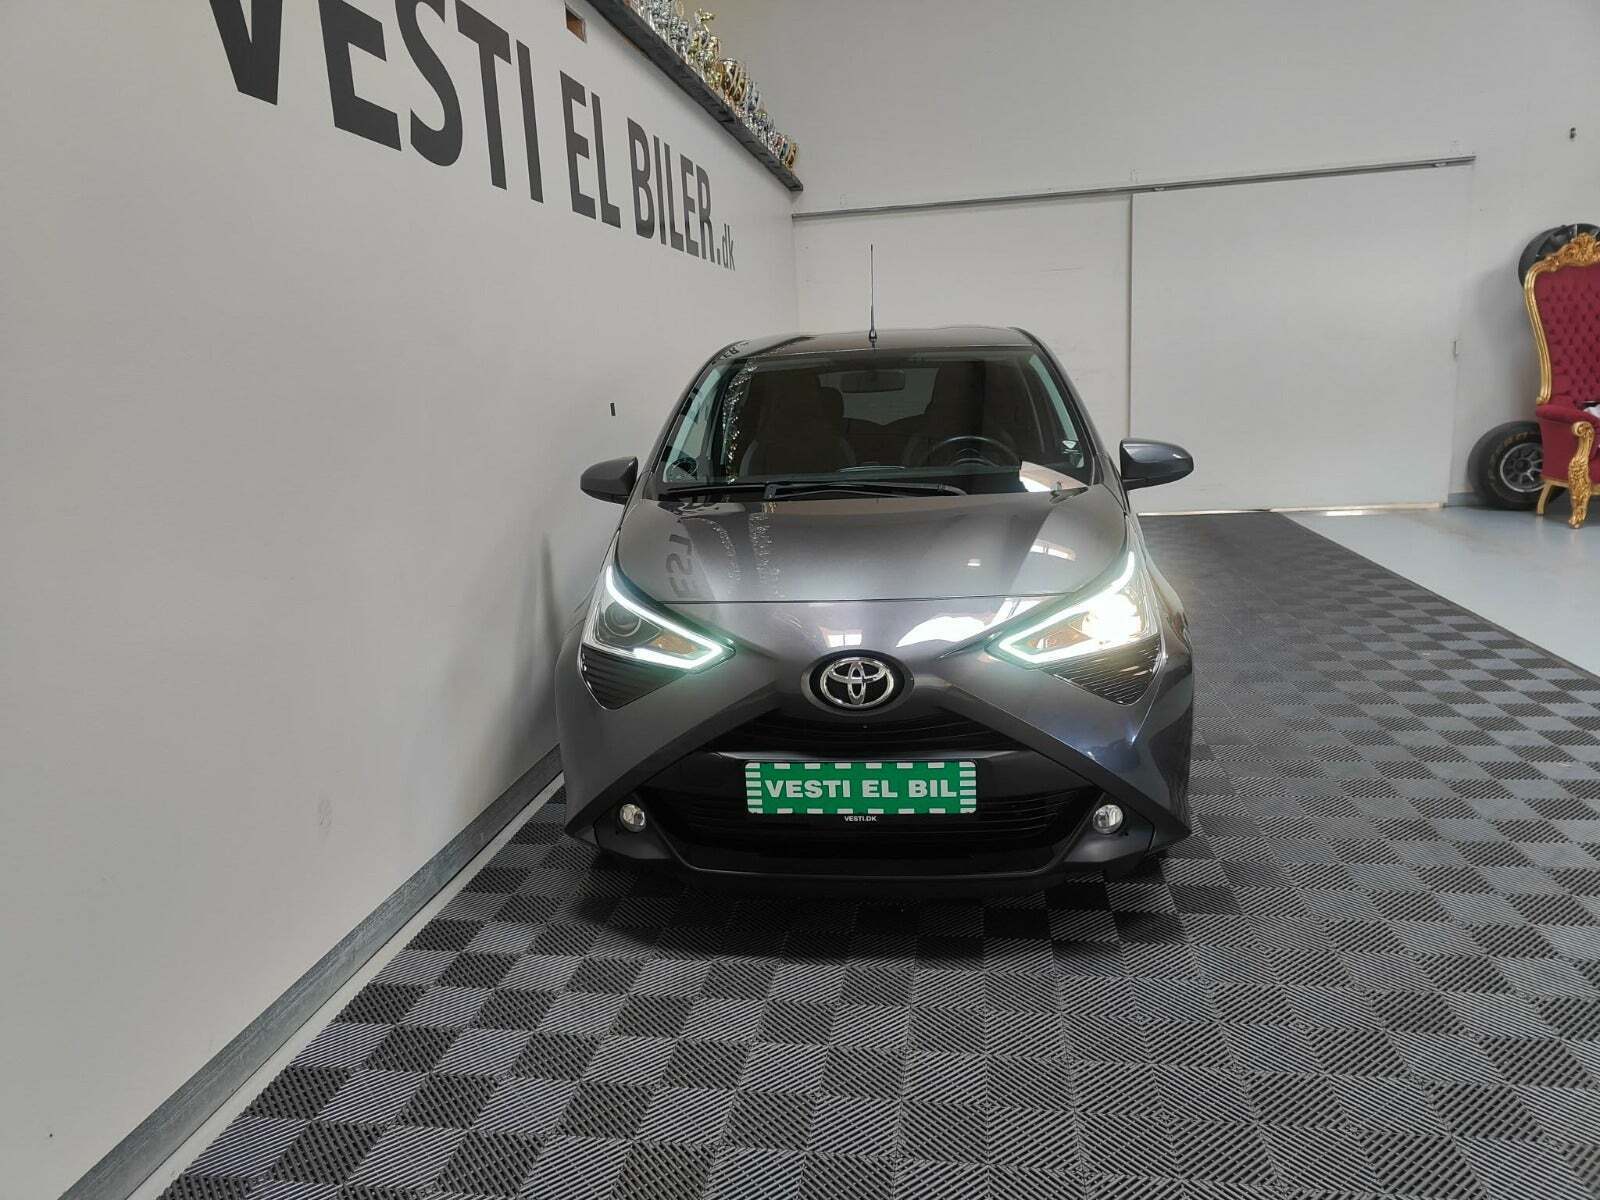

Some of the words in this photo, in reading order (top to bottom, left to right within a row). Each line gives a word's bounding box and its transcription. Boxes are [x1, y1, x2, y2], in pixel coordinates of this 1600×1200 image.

[560, 70, 622, 229] EL
[764, 780, 850, 798] VESTI
[862, 780, 898, 798] EL
[908, 780, 957, 798] BIL
